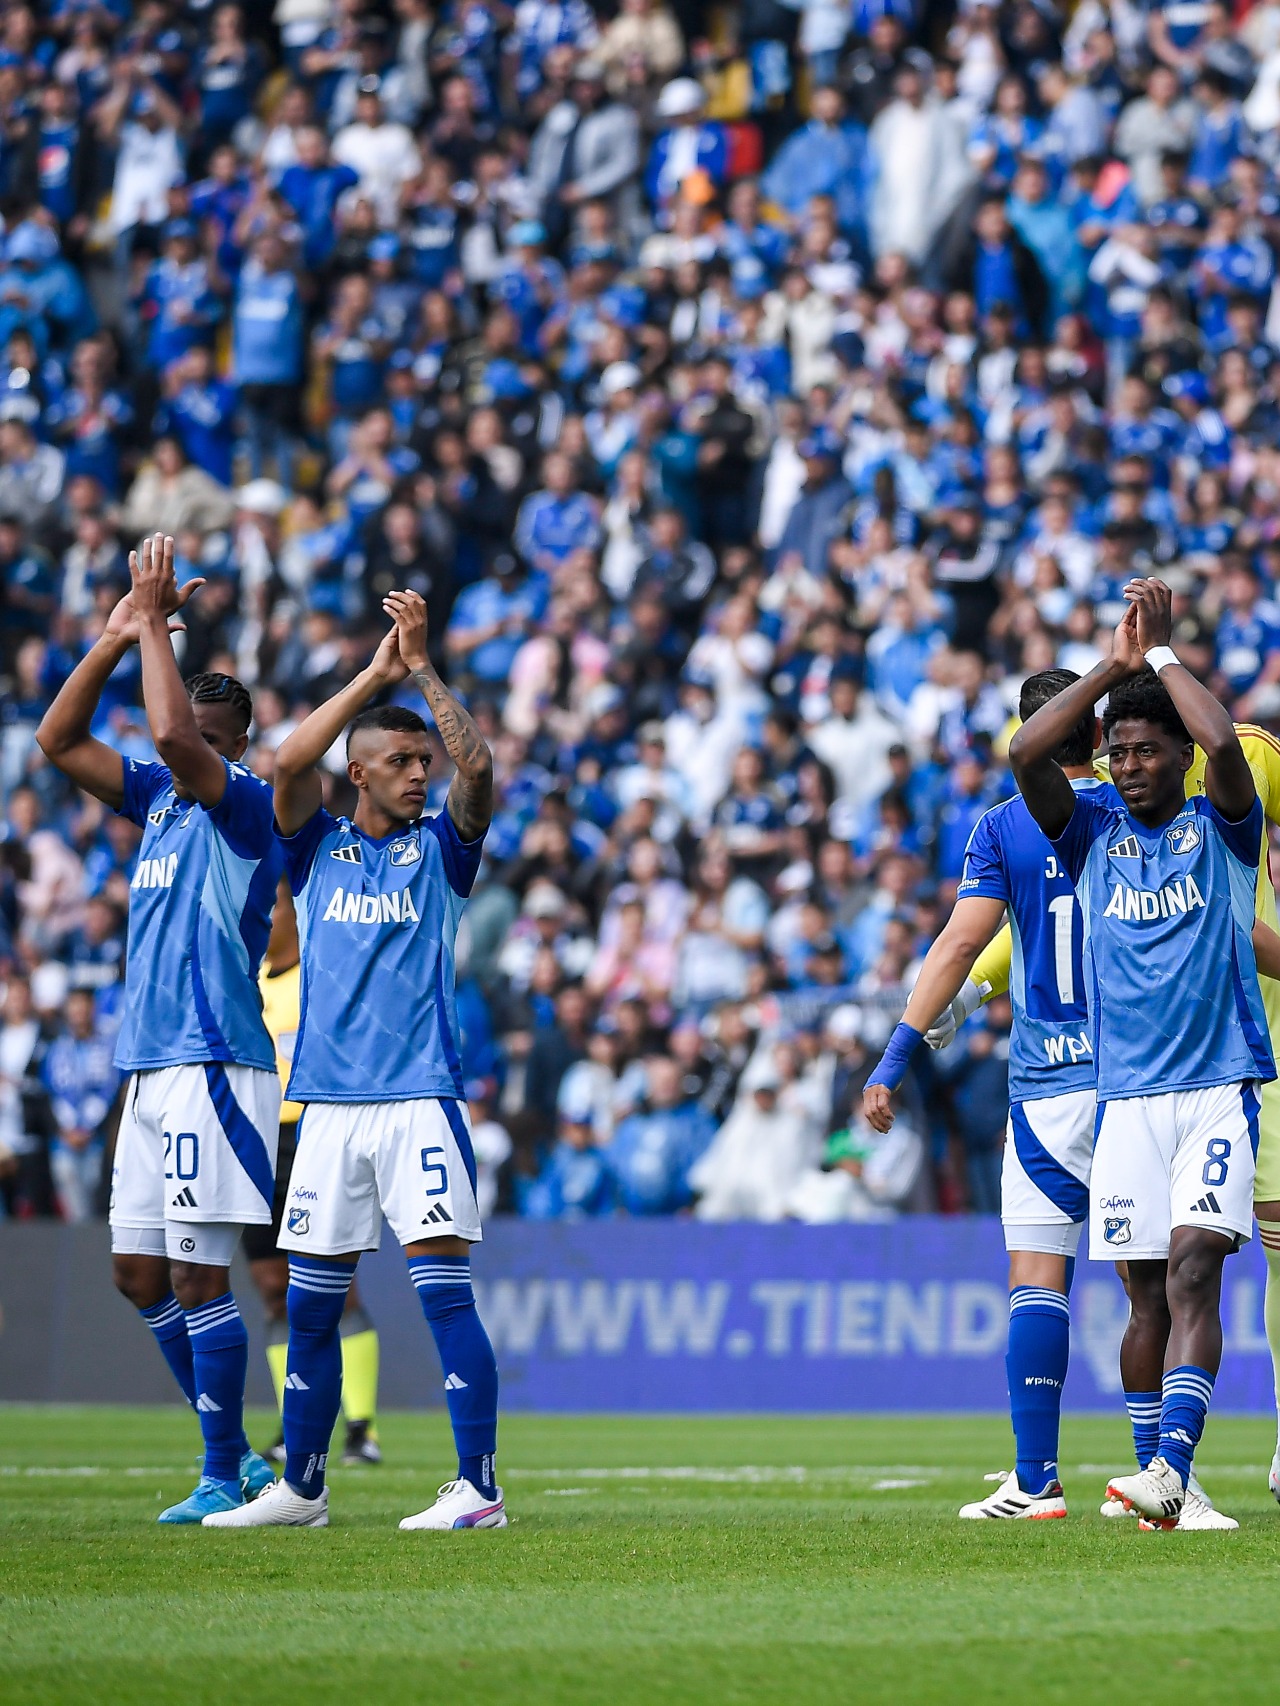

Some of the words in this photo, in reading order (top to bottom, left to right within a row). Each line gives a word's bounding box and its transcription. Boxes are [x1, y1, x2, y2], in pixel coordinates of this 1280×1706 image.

[1045, 856, 1064, 878] J.
[322, 886, 420, 924] ANDINA
[1103, 874, 1206, 921] ANDINA
[420, 1146, 448, 1197] 5
[1201, 1137, 1232, 1187] 8
